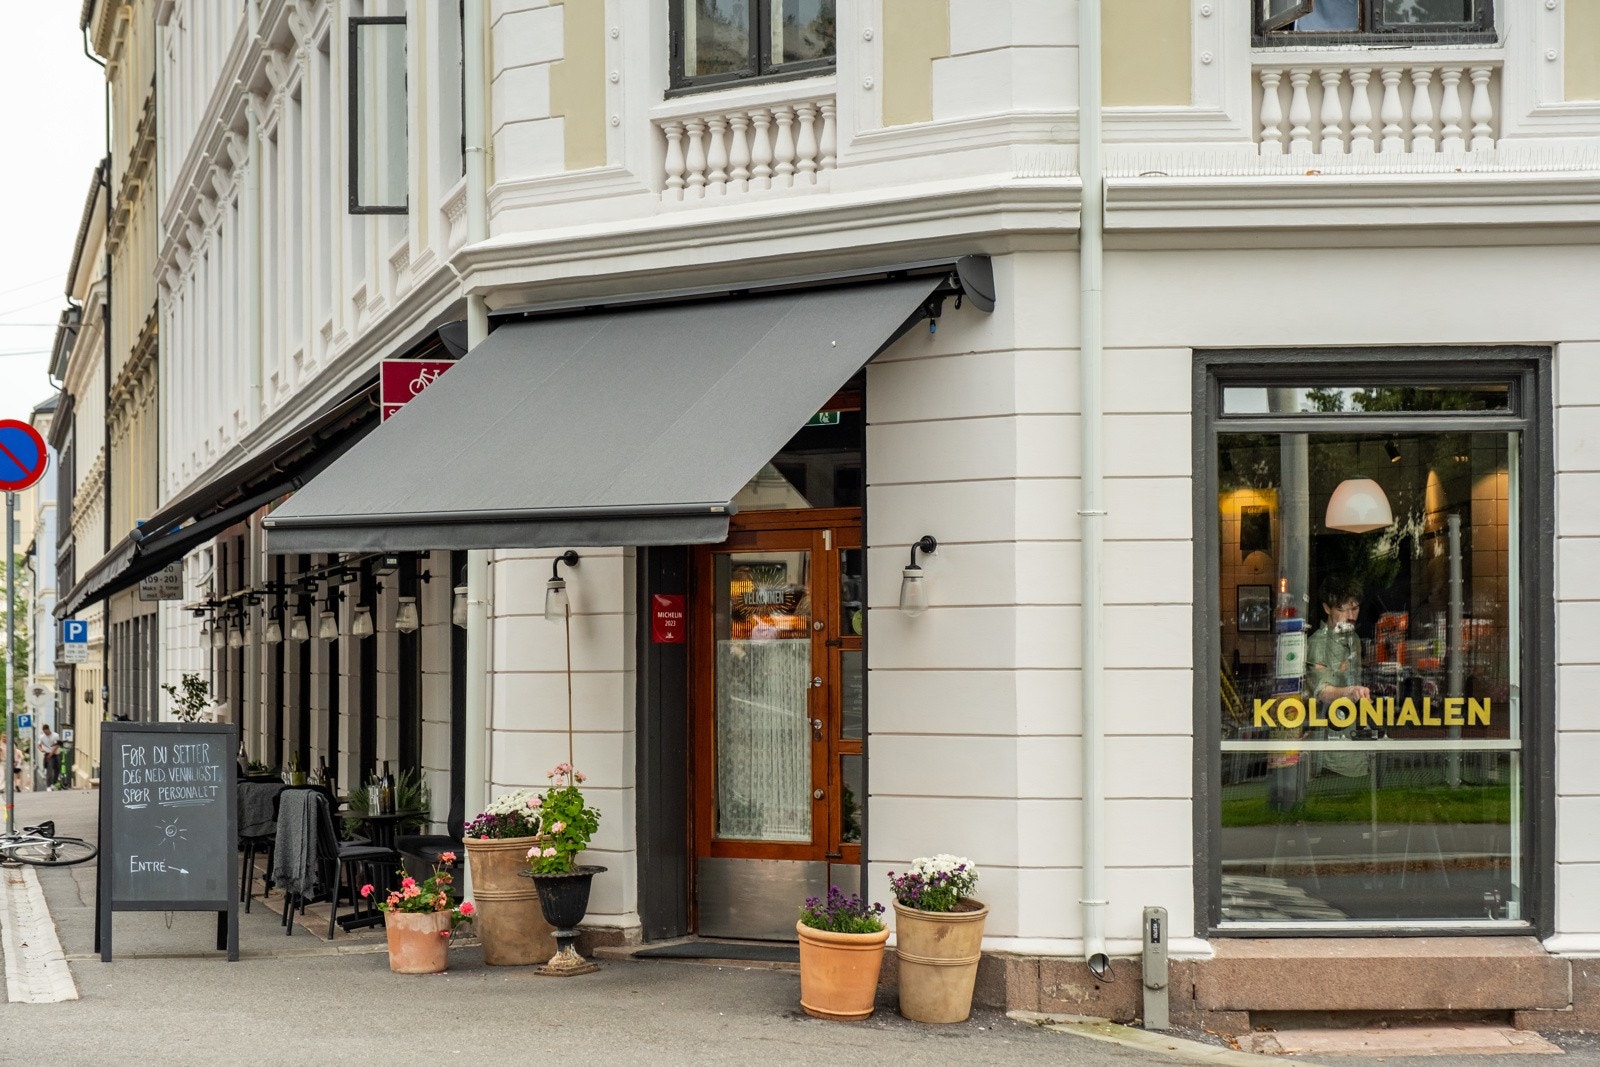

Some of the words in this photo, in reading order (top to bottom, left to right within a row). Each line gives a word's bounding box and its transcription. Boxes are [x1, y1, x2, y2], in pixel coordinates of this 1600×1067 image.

[743, 590, 784, 605] VELKOMMEN
[70, 623, 82, 640] P
[1253, 696, 1491, 728] KOLONIALEN
[20, 716, 29, 727] P
[153, 745, 168, 764] DU
[172, 743, 210, 764] SETTER
[122, 769, 142, 785] DEG
[122, 788, 150, 804] SPØR
[158, 785, 219, 801] PERSONALET
